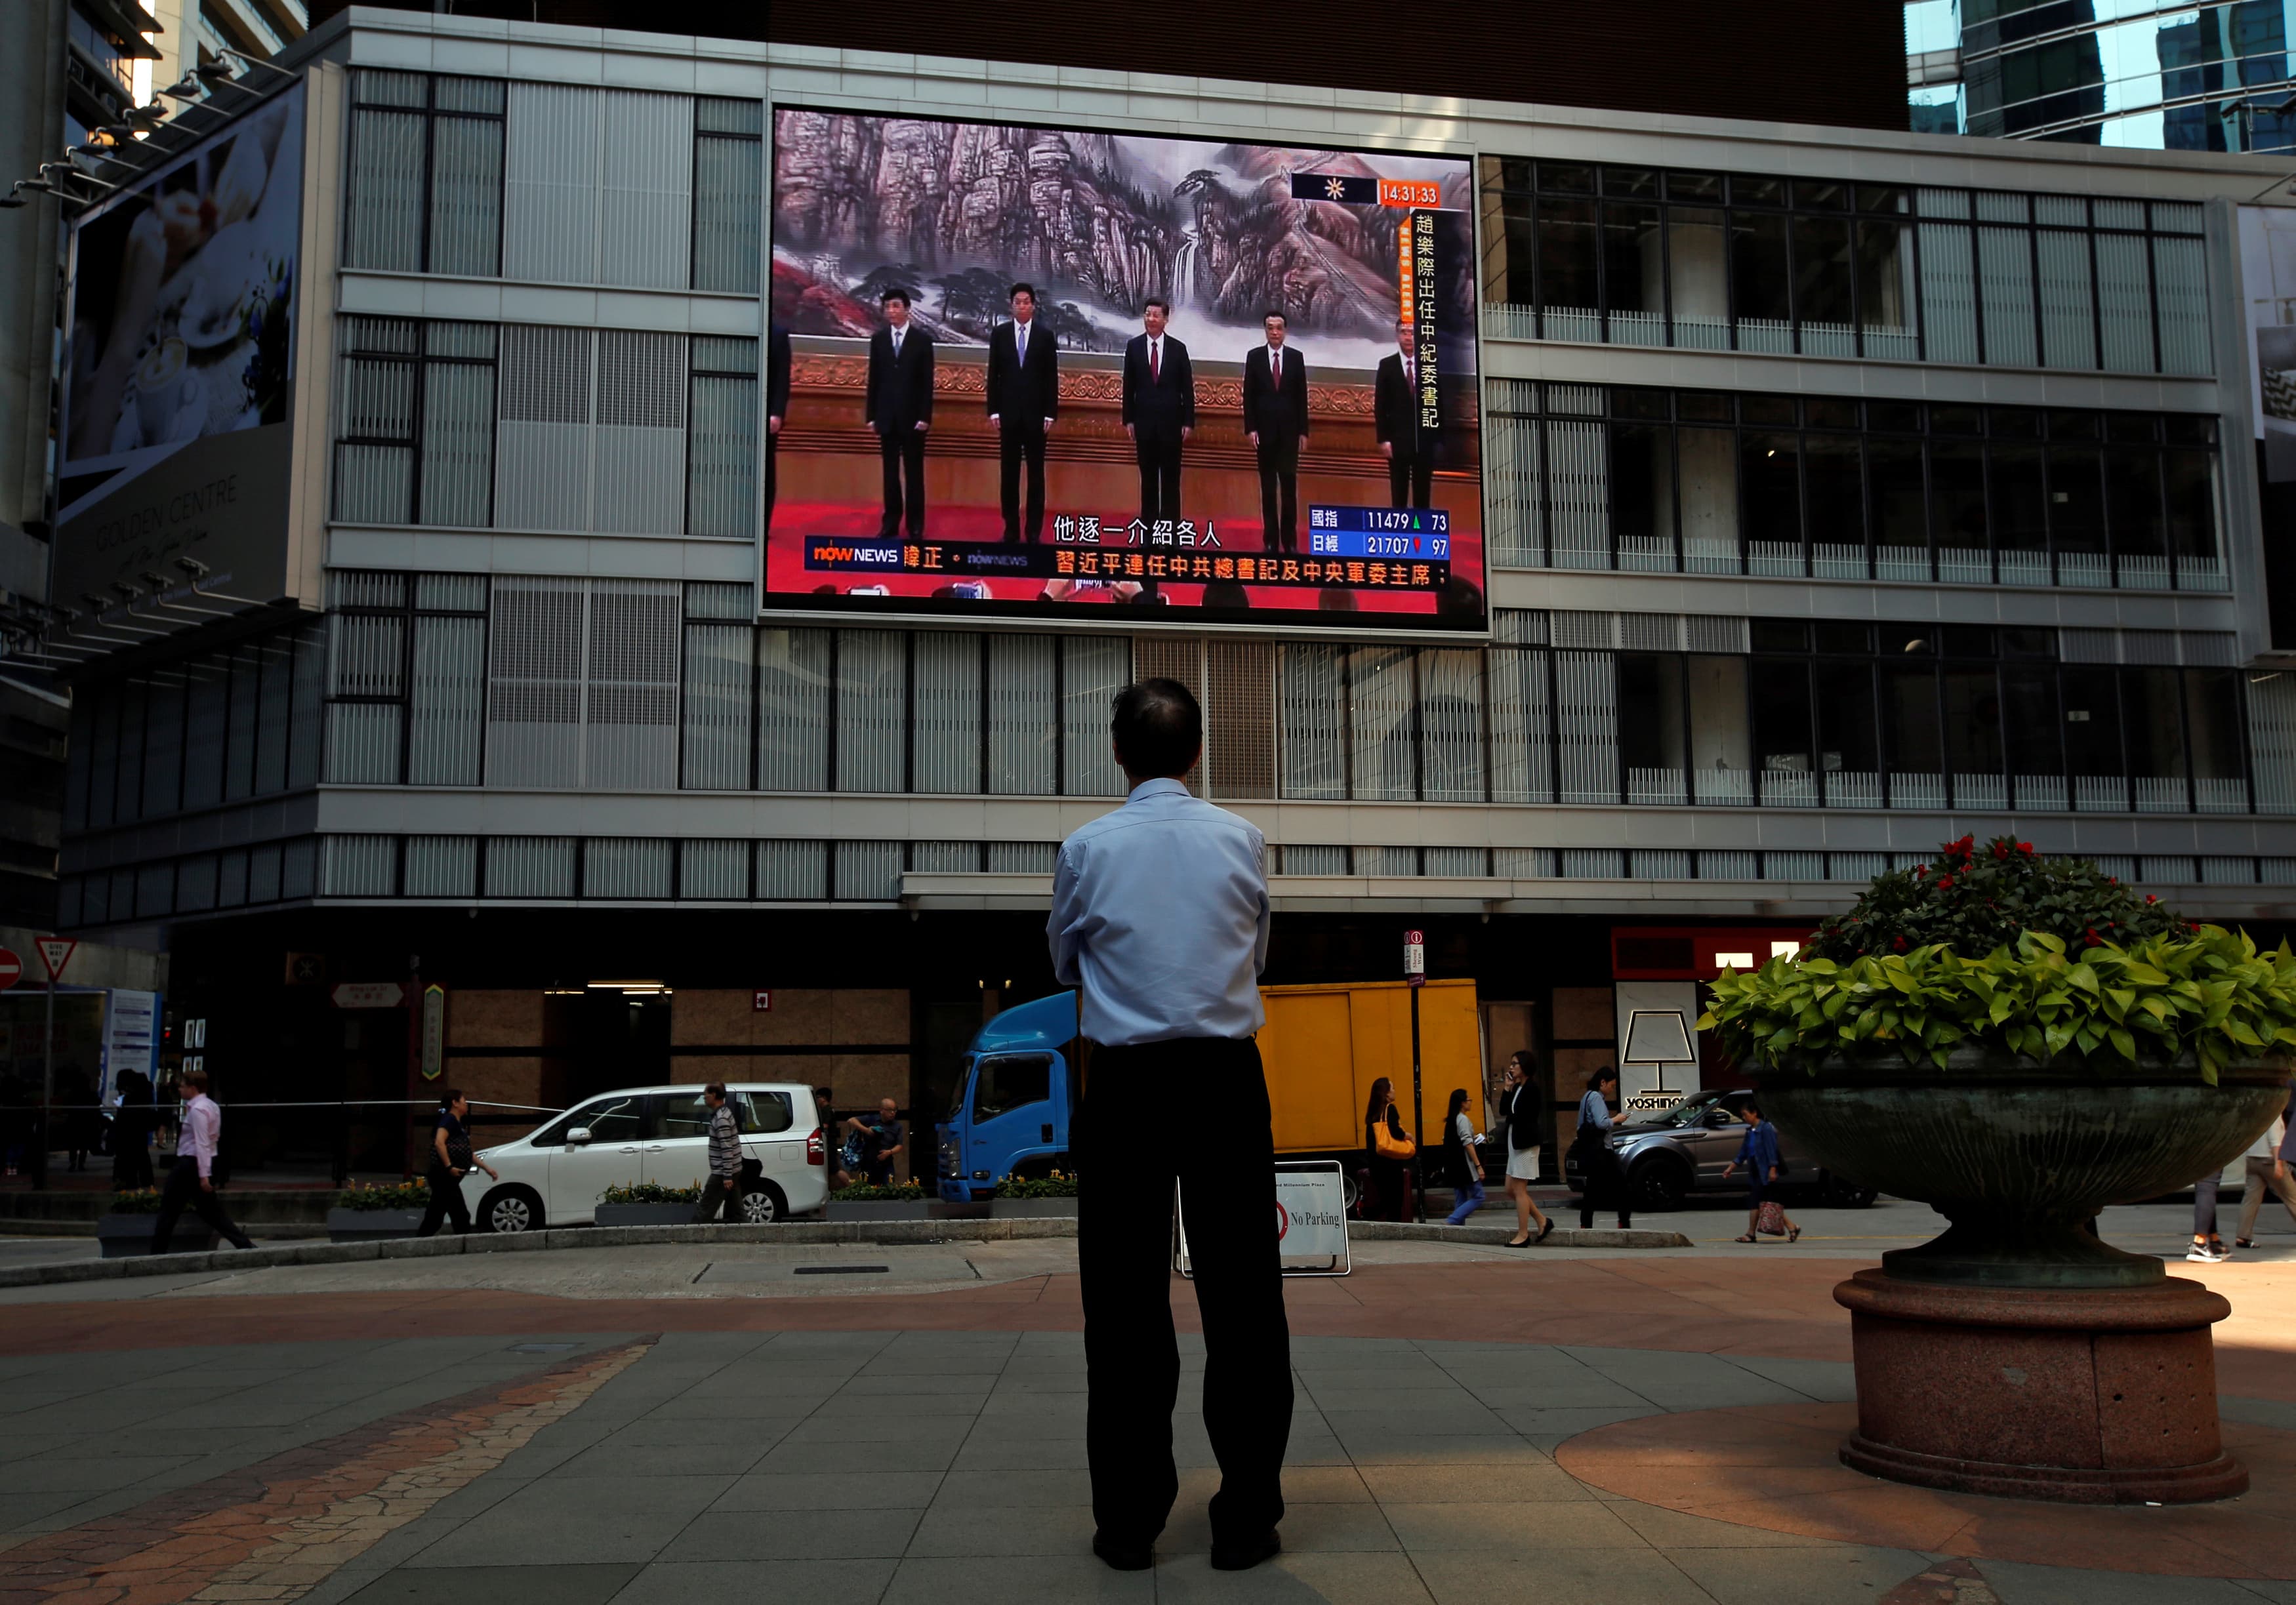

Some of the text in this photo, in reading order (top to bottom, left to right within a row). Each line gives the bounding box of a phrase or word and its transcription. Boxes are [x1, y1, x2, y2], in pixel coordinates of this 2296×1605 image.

[1384, 184, 1437, 203] 14:31:33
[1417, 214, 1439, 428] 趙樂際出任中紀委書記
[95, 503, 163, 552] GOLDEN
[169, 473, 237, 524] CENTRE
[1311, 509, 1446, 531] 國指 11479 73
[1054, 515, 1221, 548] 他逐一介紹各人
[1313, 534, 1447, 557] 日經 21707 97
[1291, 1211, 1340, 1229] No Parking
